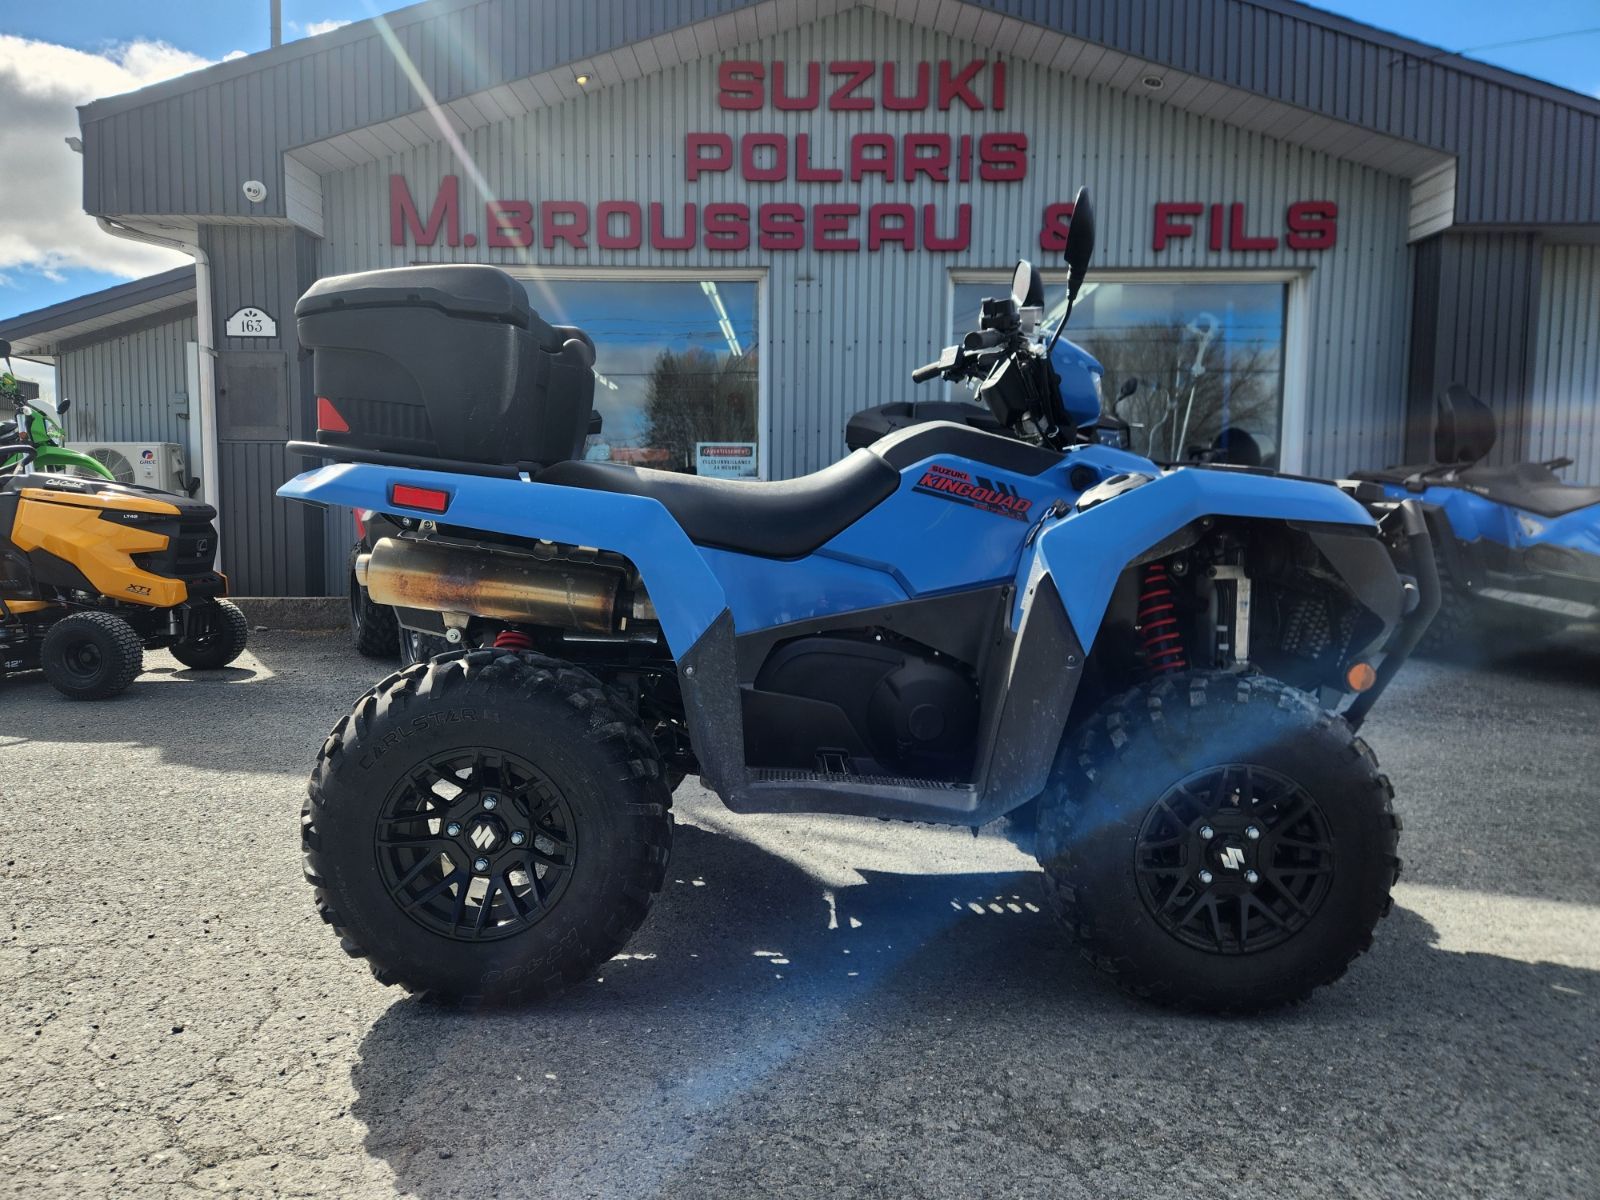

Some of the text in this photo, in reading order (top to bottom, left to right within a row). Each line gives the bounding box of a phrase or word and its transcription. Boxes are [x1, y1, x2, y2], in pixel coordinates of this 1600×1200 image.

[718, 60, 1006, 111] SUZUKI
[686, 133, 1027, 182] POLARIS
[1040, 203, 1075, 251] &
[1153, 201, 1337, 252] FILS
[241, 319, 263, 333] 163
[919, 473, 1034, 513] KINGQUAD
[931, 464, 968, 480] SUZUKI
[358, 708, 479, 770] CARLSTAR
